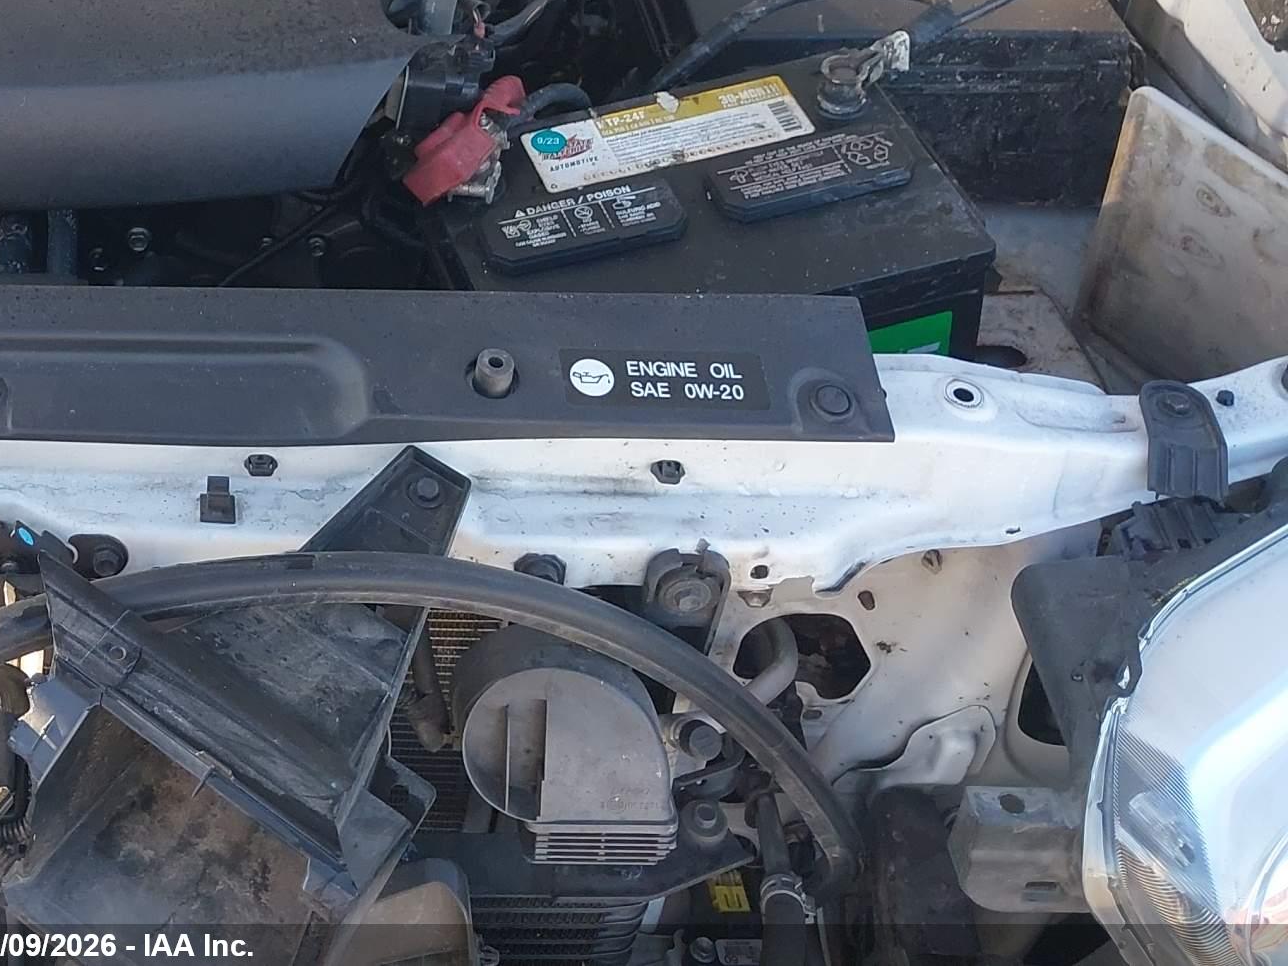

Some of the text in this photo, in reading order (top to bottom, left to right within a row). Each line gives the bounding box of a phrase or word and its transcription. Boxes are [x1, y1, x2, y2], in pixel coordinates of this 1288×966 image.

[550, 155, 600, 172] AUTOMOTIVE
[526, 197, 576, 215] DANGER
[585, 185, 631, 202] POISON
[626, 360, 744, 379] ENGINE OIL
[630, 381, 745, 400] SAE 0W-20
